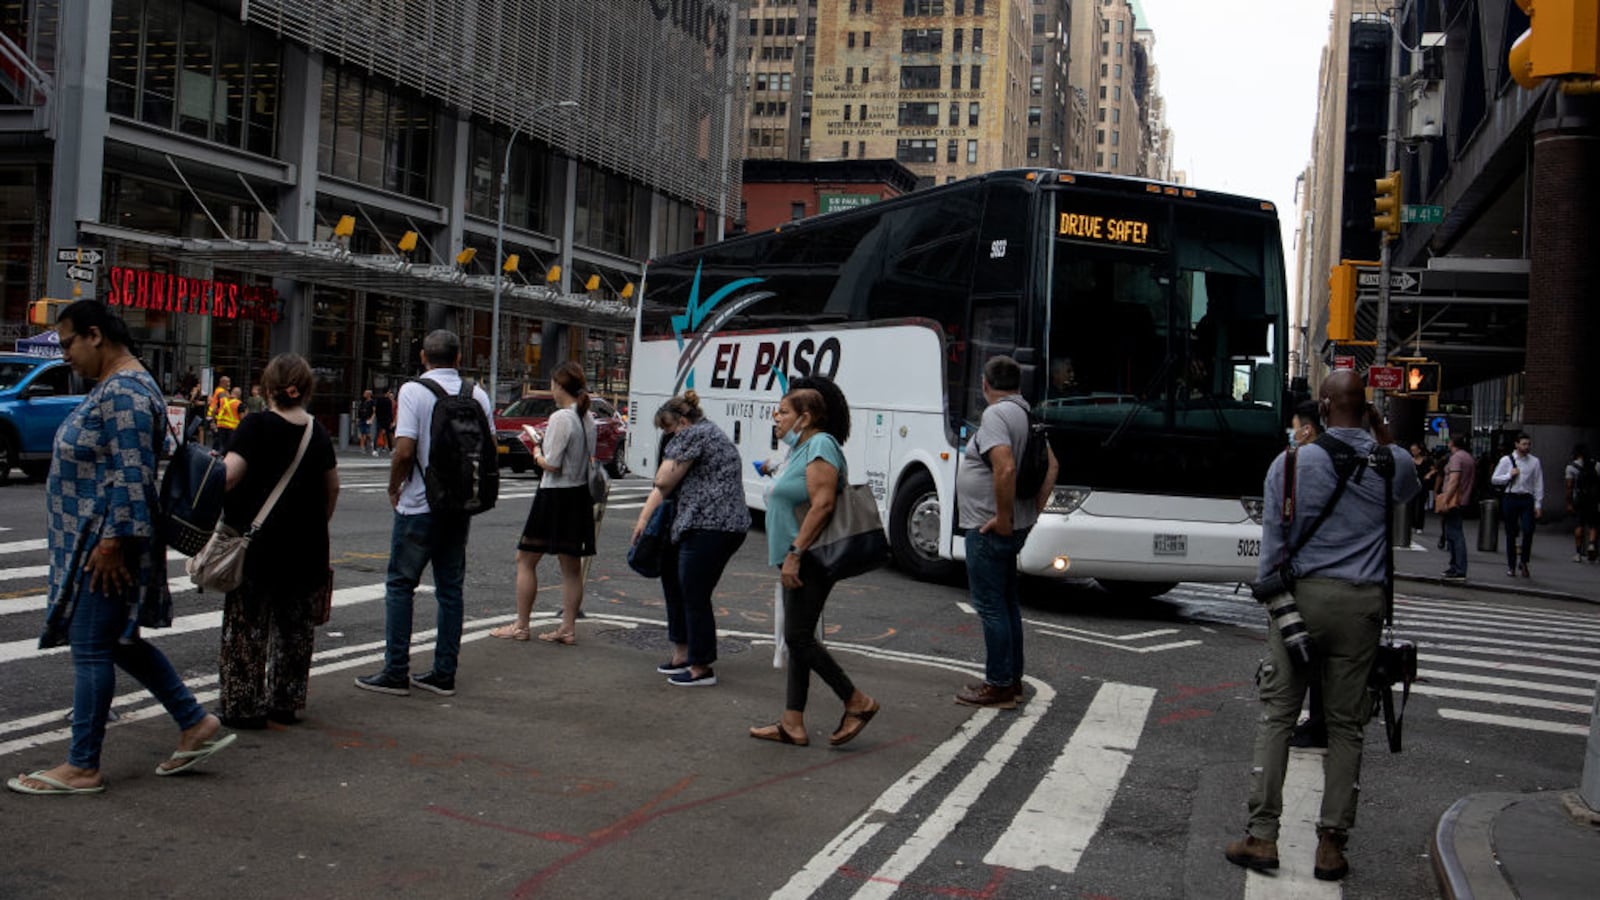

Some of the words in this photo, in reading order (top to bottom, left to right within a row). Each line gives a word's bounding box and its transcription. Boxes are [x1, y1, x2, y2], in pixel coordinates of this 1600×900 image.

[1060, 212, 1103, 239] DRIVE
[1107, 218, 1148, 244] SAFE!
[711, 343, 741, 389] EL
[750, 337, 841, 390] PASO
[1237, 539, 1261, 557] 5023
